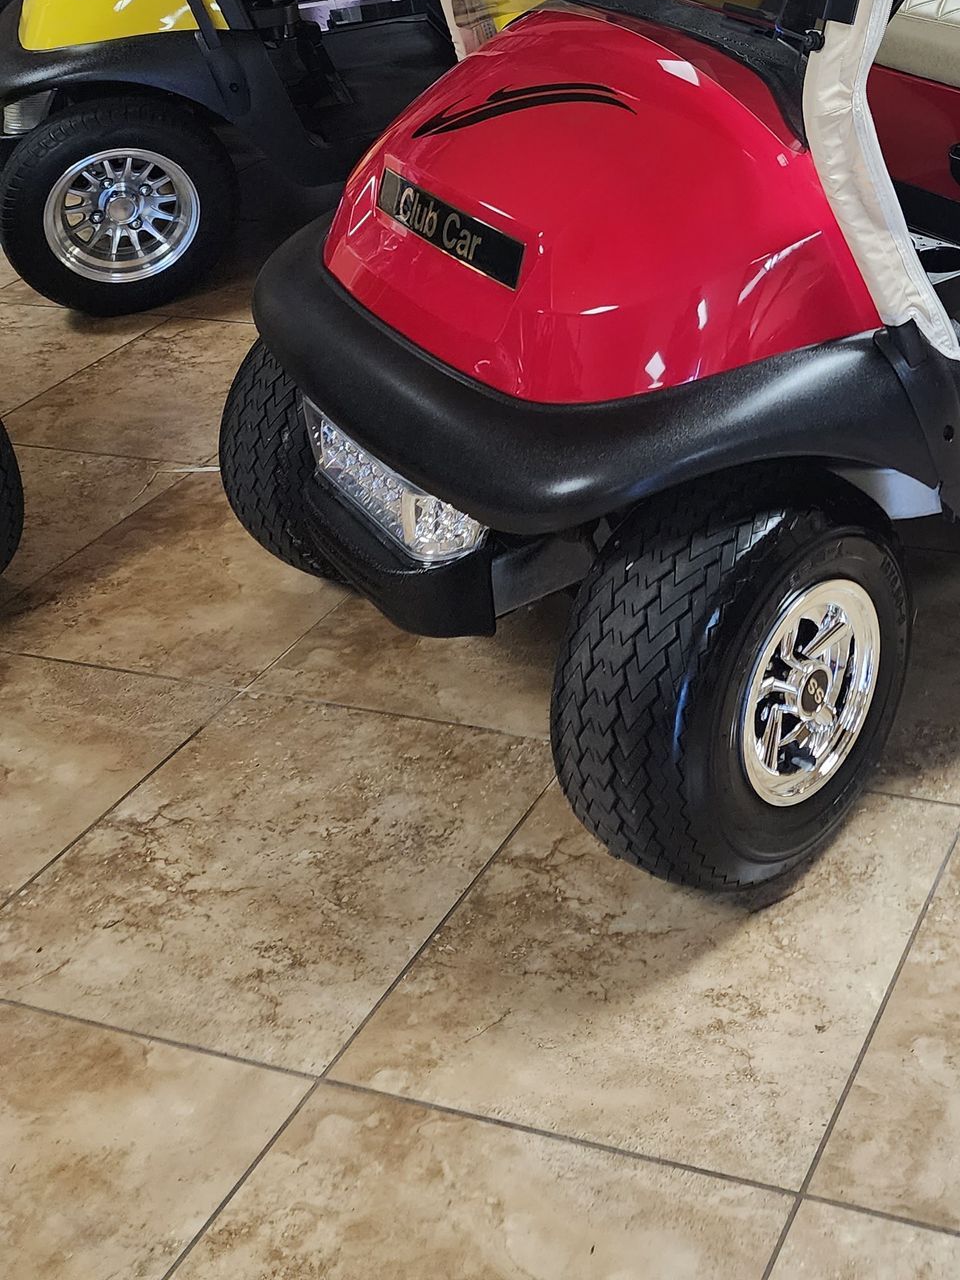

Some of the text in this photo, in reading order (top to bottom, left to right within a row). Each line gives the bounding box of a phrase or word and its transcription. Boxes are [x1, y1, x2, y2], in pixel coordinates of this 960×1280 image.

[399, 187, 482, 260] Club Car
[807, 677, 825, 704] SS
